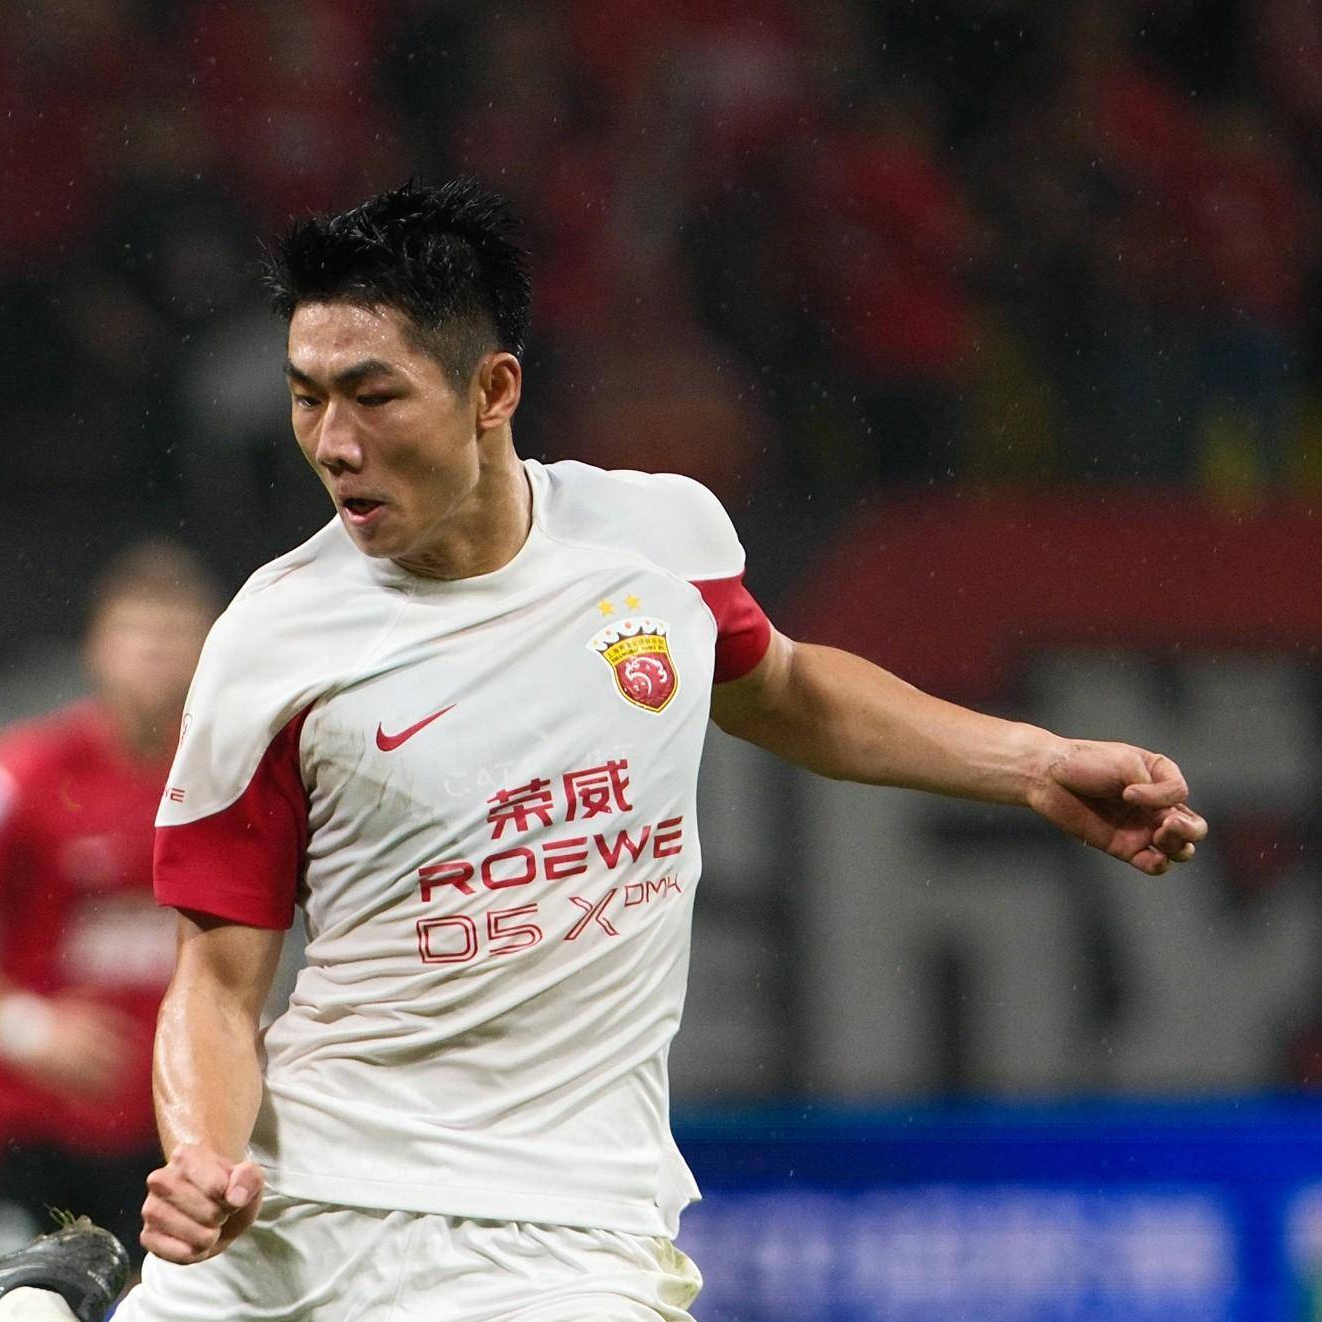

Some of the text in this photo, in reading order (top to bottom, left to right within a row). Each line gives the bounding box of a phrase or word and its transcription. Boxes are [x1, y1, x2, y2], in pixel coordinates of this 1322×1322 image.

[486, 758, 634, 841] 荣威
[417, 815, 685, 903] ROEWE
[415, 903, 544, 964] D5
[564, 887, 621, 941] X
